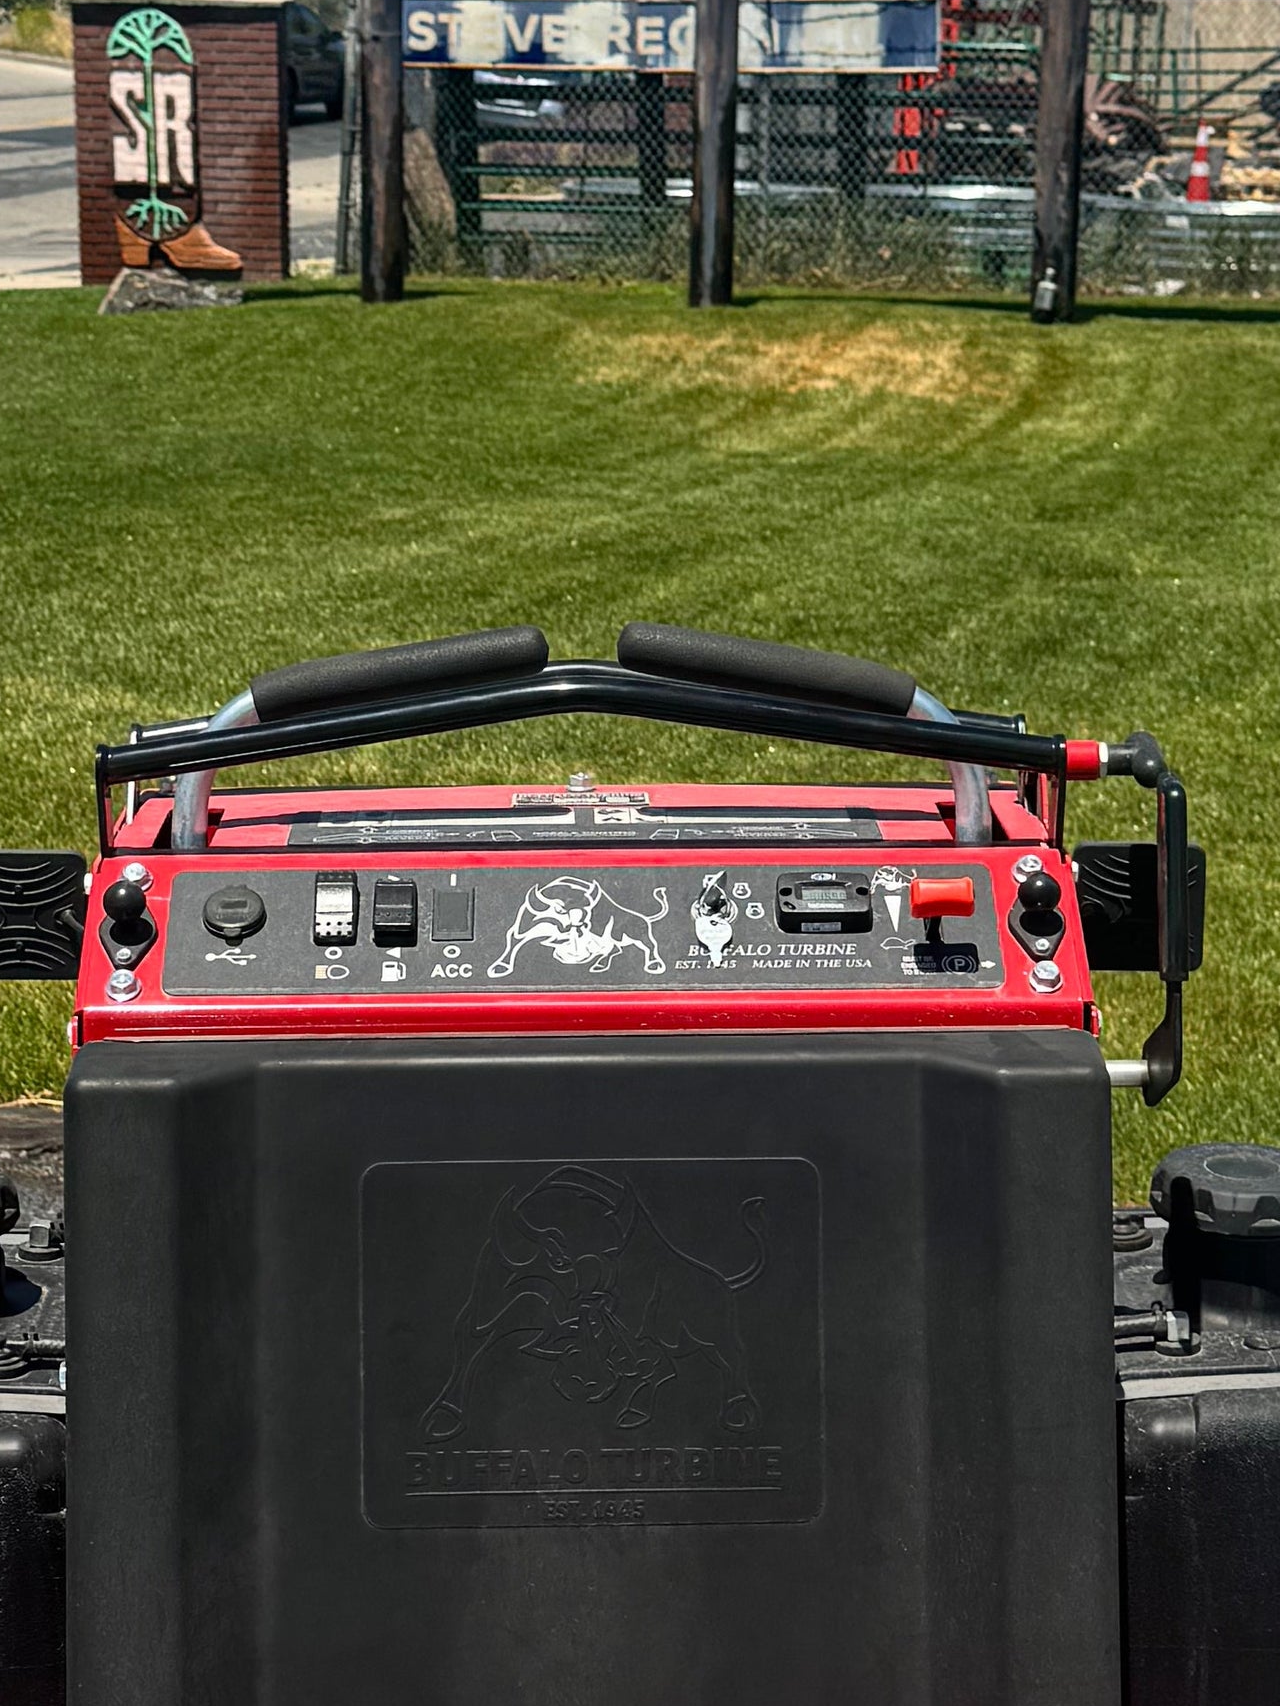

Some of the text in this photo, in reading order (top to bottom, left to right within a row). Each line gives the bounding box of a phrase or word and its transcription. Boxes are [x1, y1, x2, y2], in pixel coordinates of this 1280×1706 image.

[109, 70, 195, 185] SR
[777, 943, 857, 956] TURBINE
[430, 963, 473, 978] ACC
[675, 958, 873, 969] EST. 145 MADE IN THE USA
[405, 1446, 783, 1487] BUFFALO TURBINE
